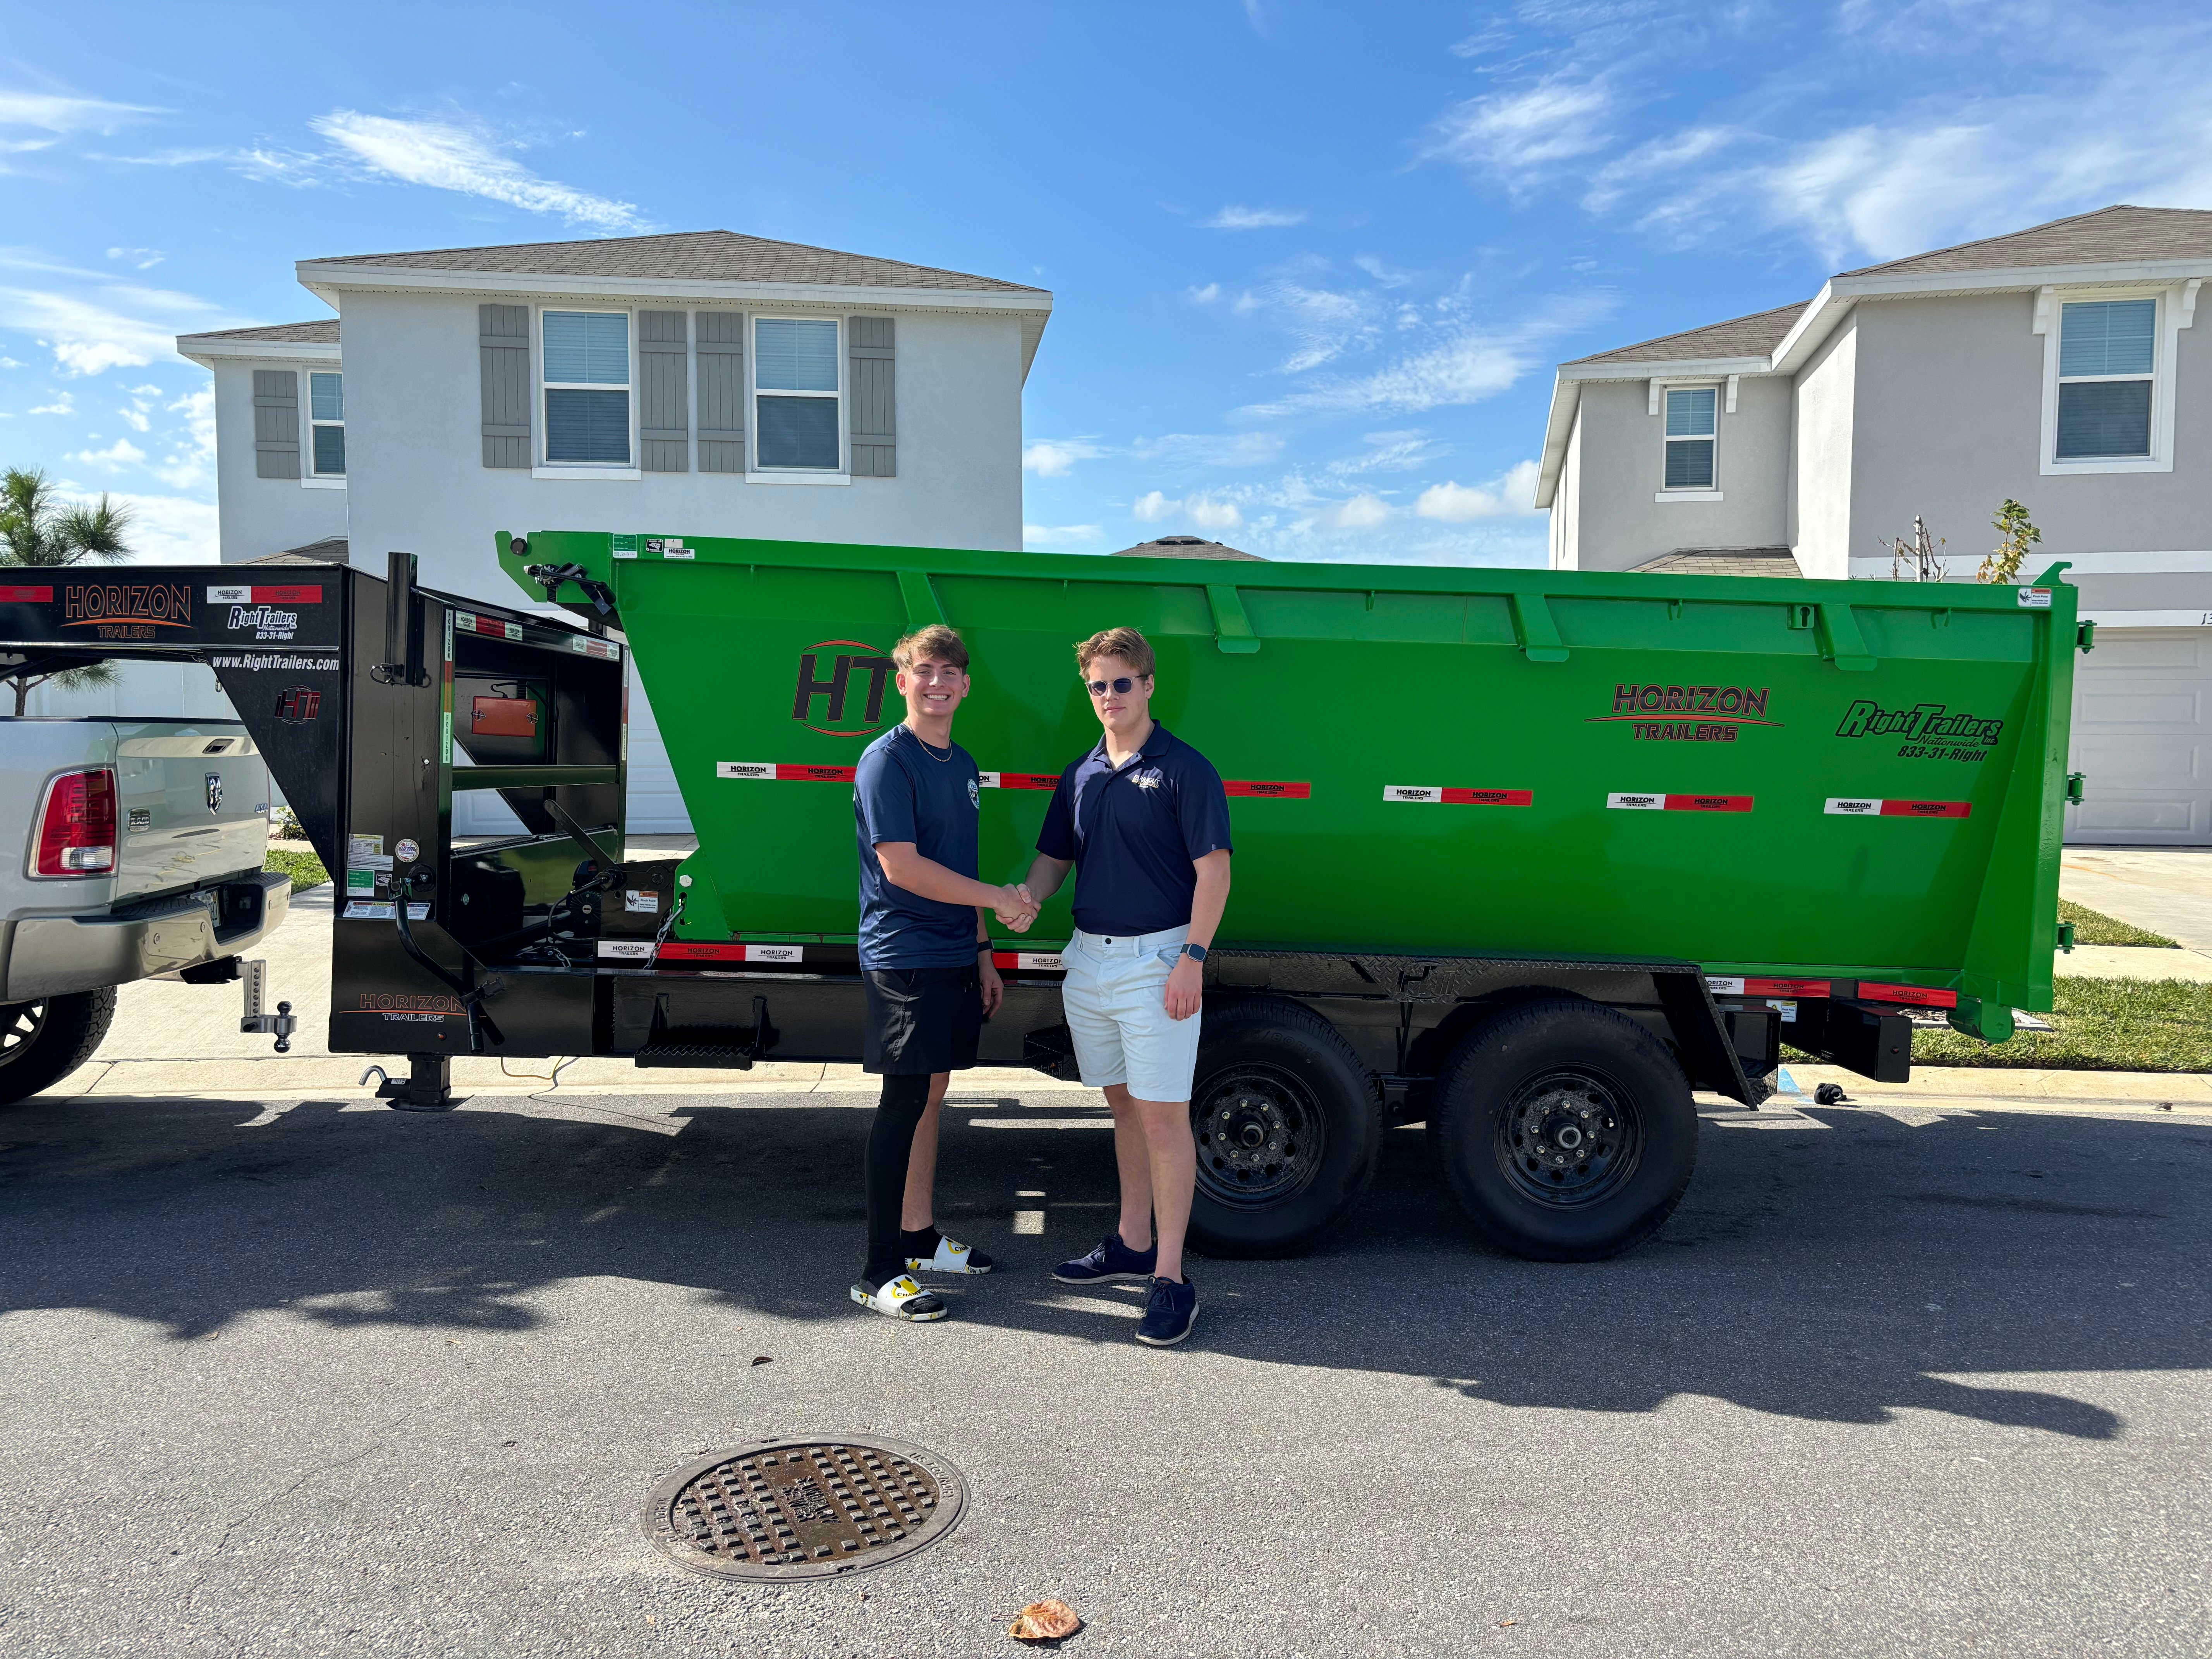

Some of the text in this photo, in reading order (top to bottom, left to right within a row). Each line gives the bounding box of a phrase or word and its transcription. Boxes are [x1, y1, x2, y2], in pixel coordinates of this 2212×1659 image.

[66, 584, 191, 622] HORIZON
[228, 606, 297, 629] RightTrailers
[98, 626, 155, 639] TRAILERS
[256, 631, 294, 640] 833-31-Right
[213, 654, 339, 671] www.RightTrailers.com
[792, 653, 898, 723] HT
[1612, 684, 1770, 717] HORIZON
[1835, 700, 2004, 741] RightTrailers
[1632, 723, 1739, 742] TRAILERS
[1914, 735, 1981, 748] Nationwide
[1898, 745, 1988, 762] 833-31-Right
[383, 1013, 444, 1022] TRAILERS
[909, 1452, 929, 1462] US
